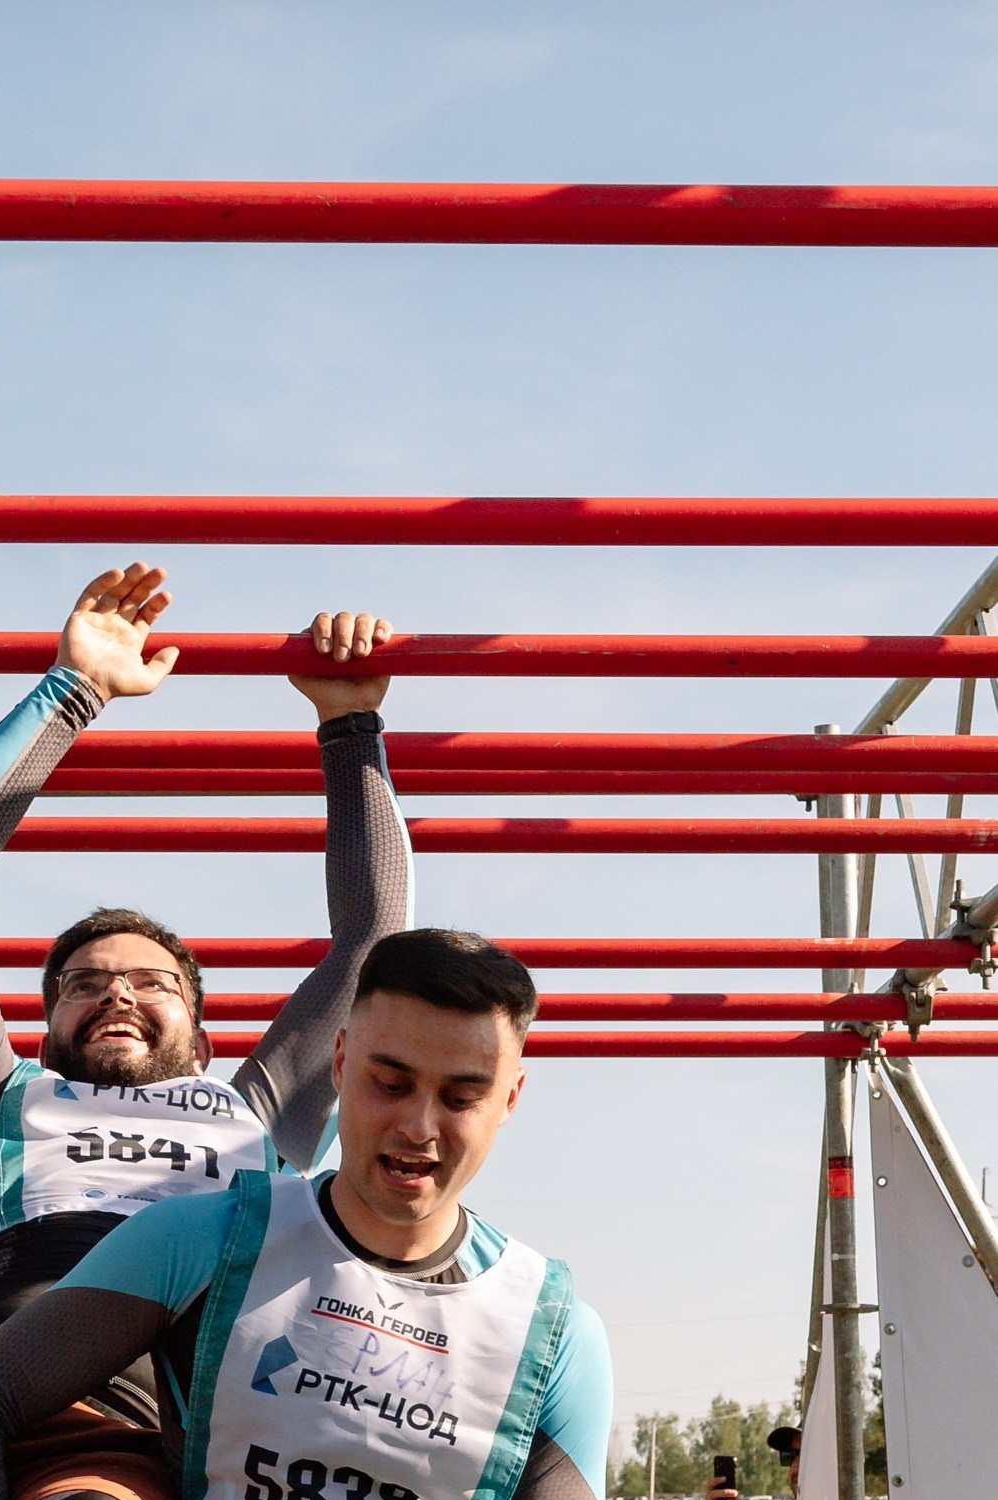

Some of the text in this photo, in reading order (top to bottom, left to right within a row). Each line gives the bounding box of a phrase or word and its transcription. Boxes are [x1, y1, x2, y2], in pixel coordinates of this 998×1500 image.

[66, 1126, 220, 1180] 5841
[316, 1296, 449, 1348] ГОНКА ГЕРОЕВ
[294, 1368, 459, 1446] РТК-ЦОД
